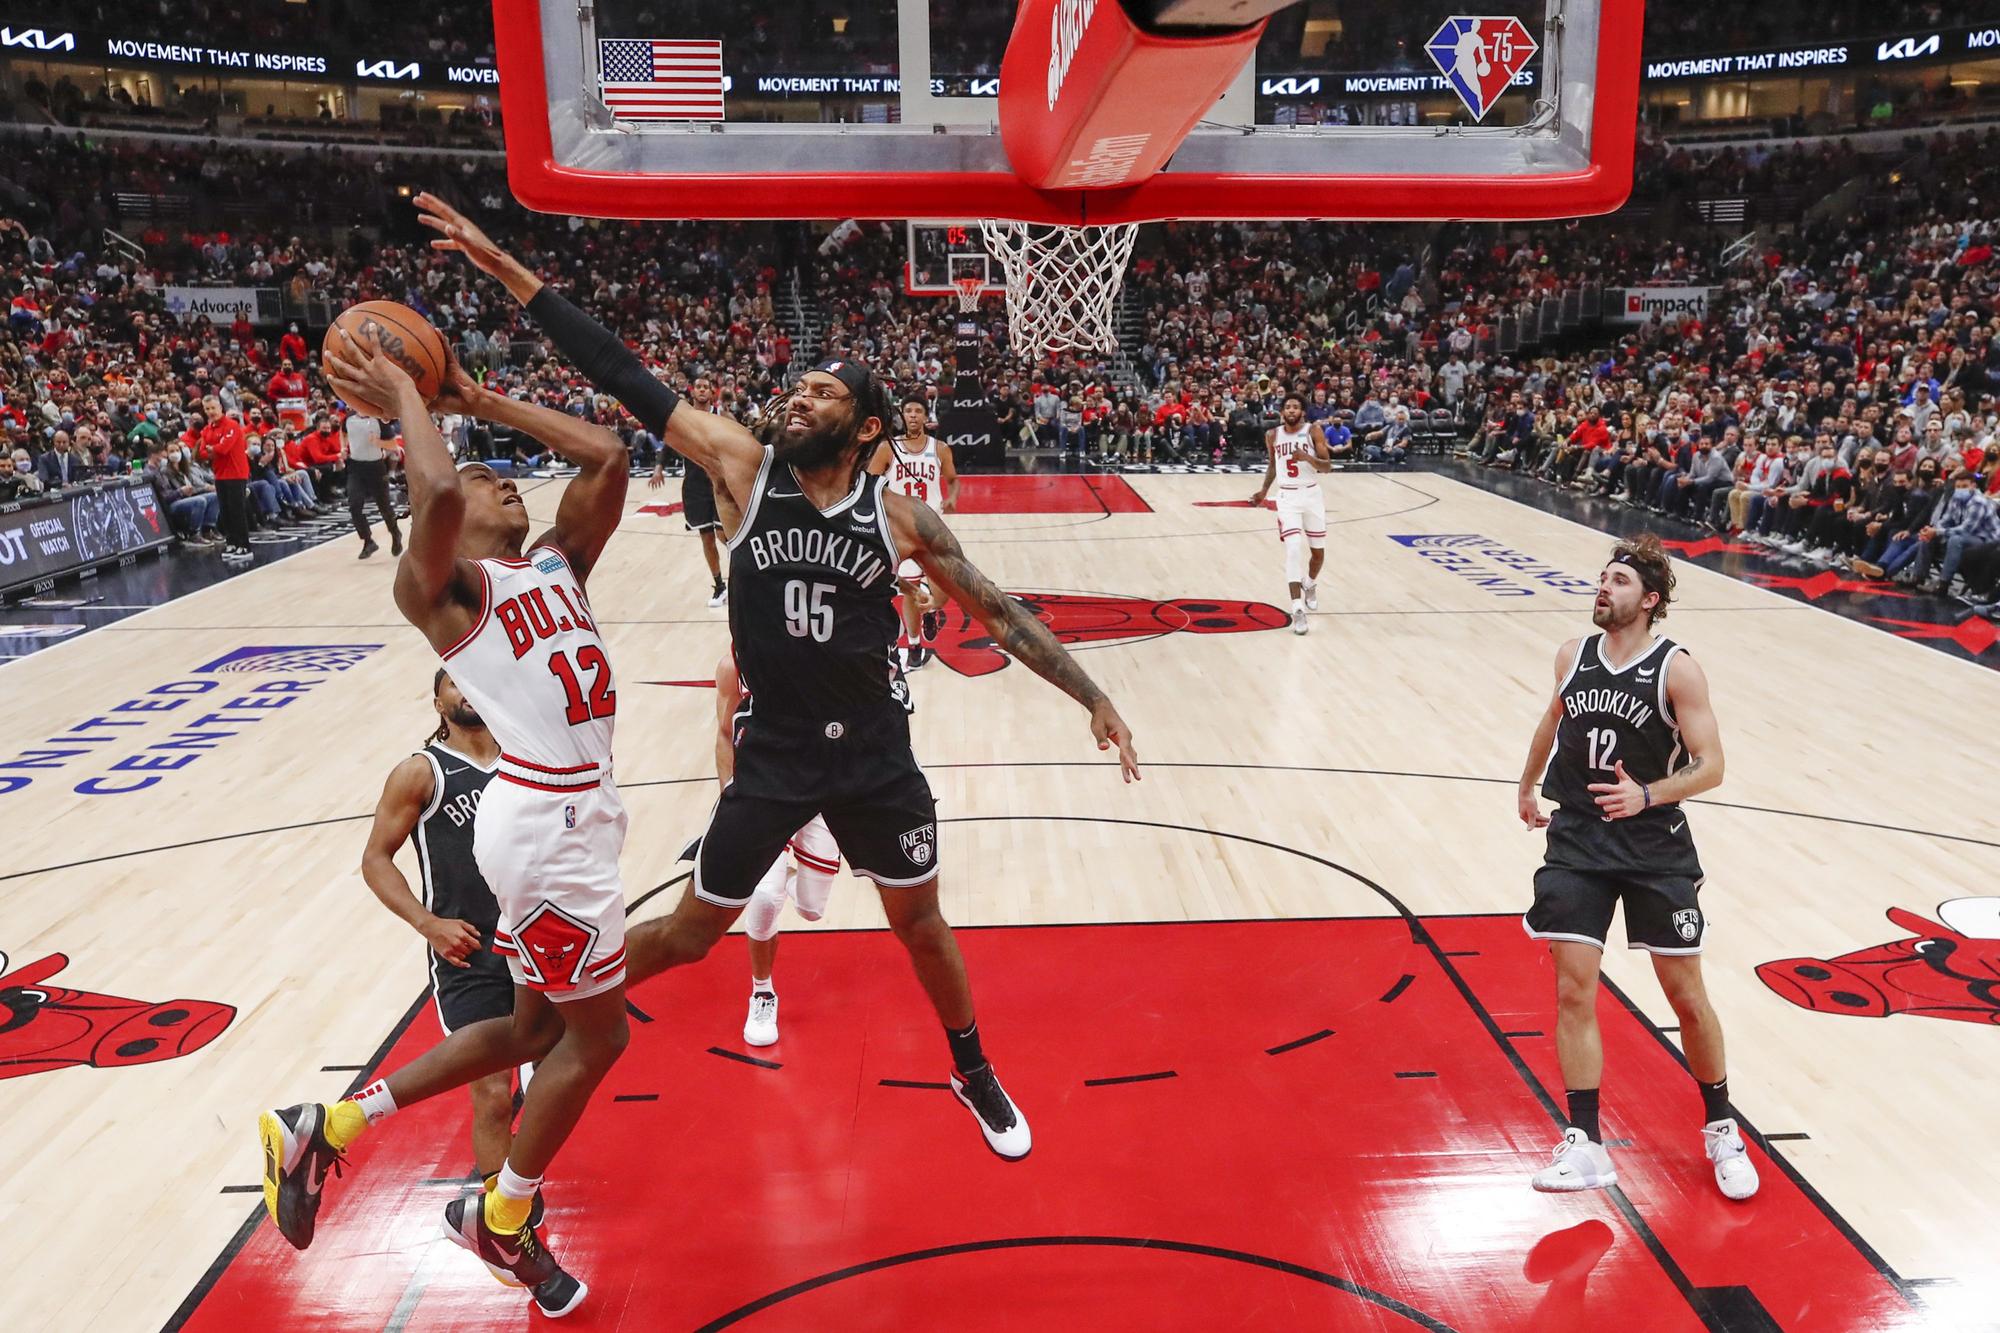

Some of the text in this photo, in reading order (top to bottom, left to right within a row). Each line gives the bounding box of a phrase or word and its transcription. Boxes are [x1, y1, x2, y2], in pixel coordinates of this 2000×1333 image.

[108, 39, 326, 73] MOVEMENT THAT INSPIRES
[1492, 32, 1513, 64] 75
[448, 66, 500, 84] MOVEM
[1647, 47, 1848, 79] MOVEMENT THAT INSPIRES
[758, 77, 838, 92] MOVEMENT
[843, 78, 880, 92] THAT
[1345, 76, 1453, 93] MOVEMENT TH
[190, 298, 253, 313] Advocate
[1641, 292, 1704, 316] impact
[896, 462, 935, 481] BULLS
[1286, 460, 1299, 478] 5
[29, 517, 65, 538] OFFICIAL
[851, 524, 876, 534] Webull
[39, 535, 70, 556] WATCH
[750, 528, 886, 589] BROOKLYN
[1418, 550, 1536, 596] UNITED
[1481, 550, 1599, 596] CENTER
[784, 580, 837, 643] 95
[547, 644, 617, 727] 12
[1565, 689, 1653, 729] BROOKLYN
[73, 679, 327, 795] CENTER
[1586, 727, 1618, 771] 12
[902, 826, 934, 849] NETS
[1675, 910, 1699, 926] NETS
